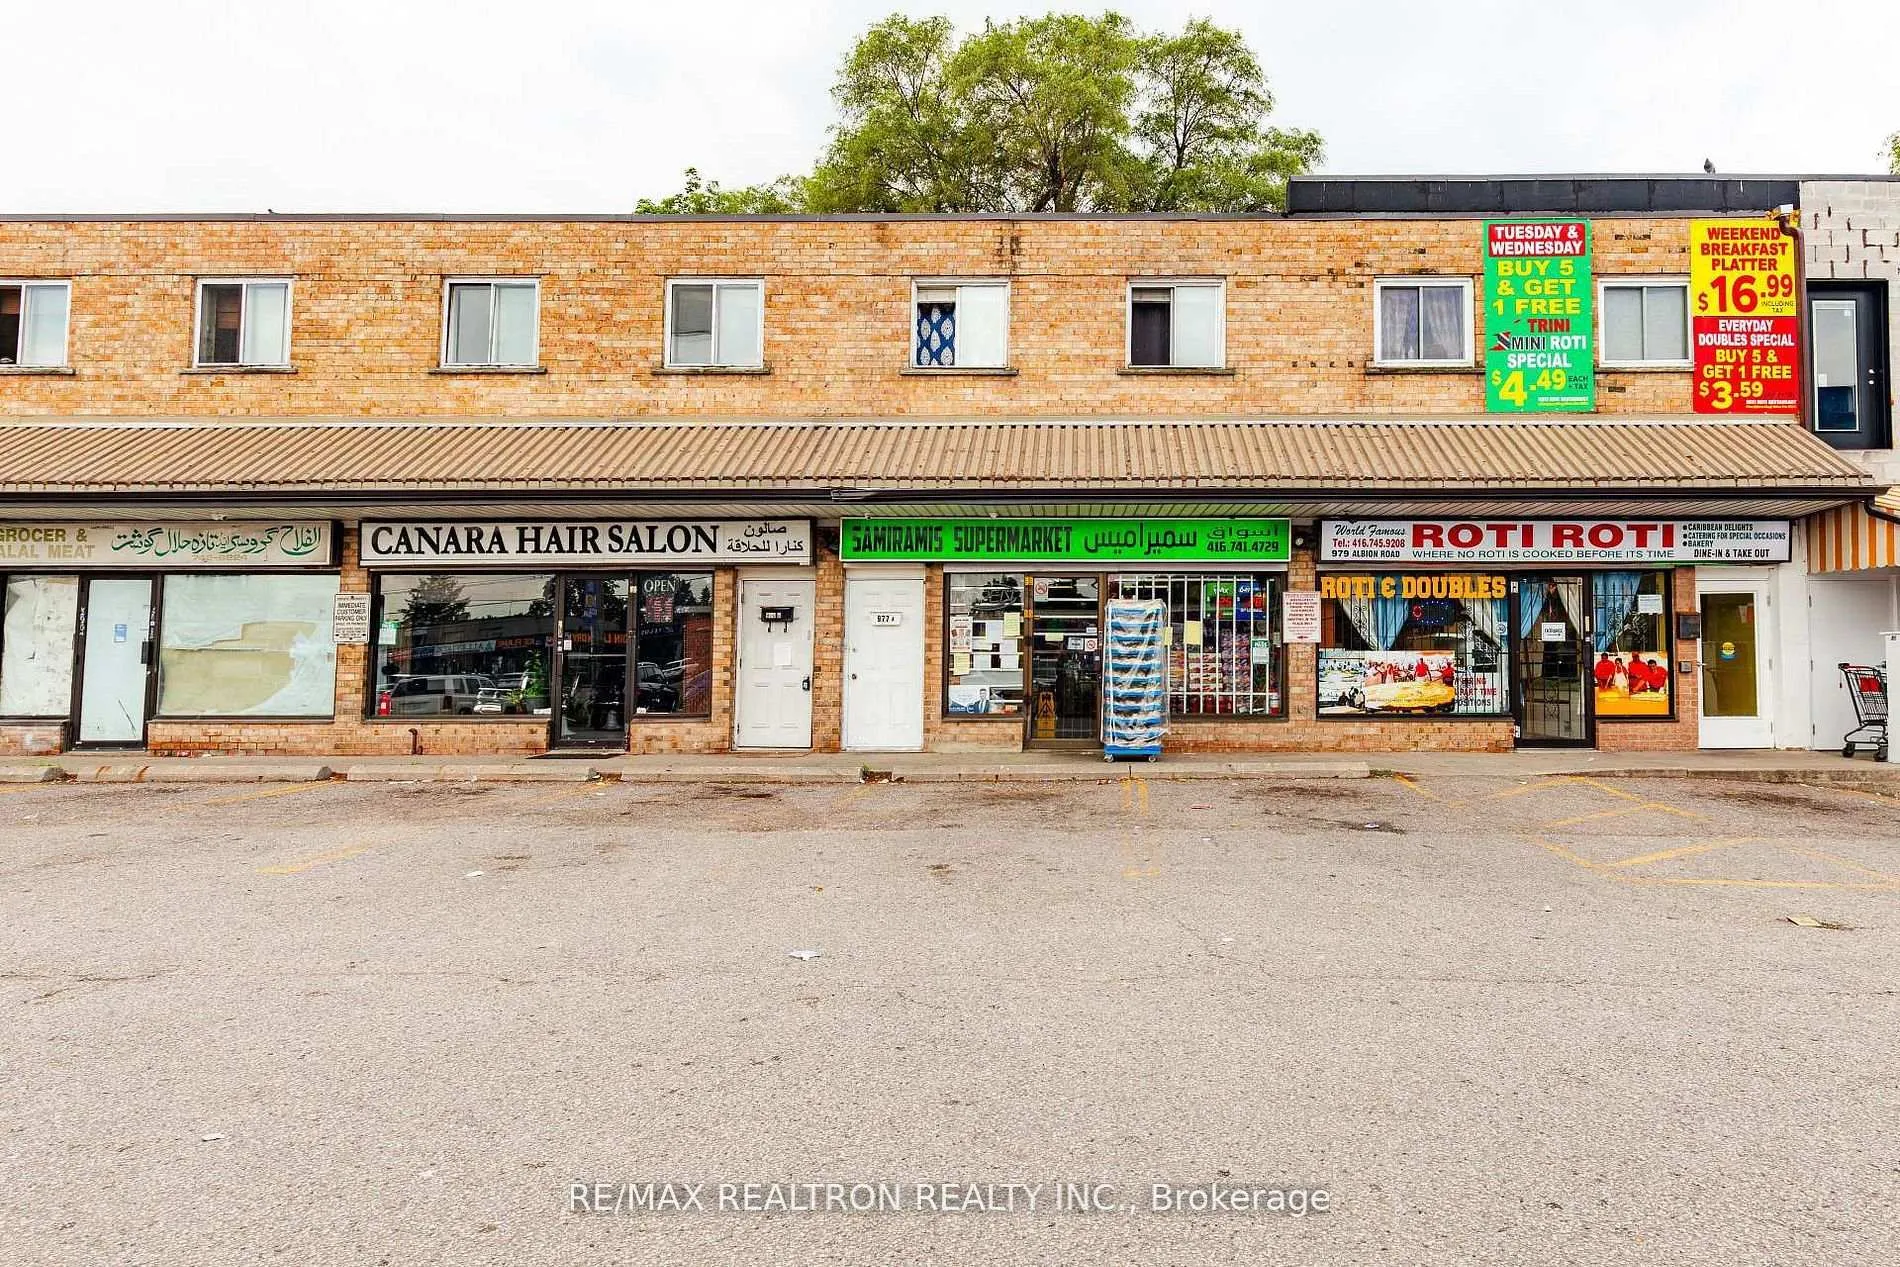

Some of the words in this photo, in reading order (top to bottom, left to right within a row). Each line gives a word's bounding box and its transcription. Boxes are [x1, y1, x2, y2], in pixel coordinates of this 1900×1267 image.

[1495, 225, 1563, 239] TUESDAY
[1567, 225, 1579, 239] &
[1707, 227, 1781, 241] WEEKEND
[1491, 240, 1583, 255] WEDNESDAY
[1700, 243, 1788, 256] BREAKFAST
[1497, 260, 1551, 276] BUY
[1560, 259, 1574, 276] 5
[1711, 258, 1778, 271] PLATTER
[1497, 279, 1515, 296] &
[1524, 279, 1576, 296] GET
[1698, 274, 1793, 313] $16.99
[1493, 299, 1504, 316] 1
[1515, 298, 1580, 315] FREE
[1528, 318, 1570, 333] TRINI
[1718, 319, 1774, 332] EVERYDAY
[1511, 336, 1546, 350] MINI
[1550, 335, 1587, 350] ROTI
[1698, 333, 1748, 346] DOUBLES
[1750, 333, 1795, 346] SPECIAL
[1507, 352, 1572, 368] SPECIAL
[1715, 349, 1748, 363] BUY
[1752, 349, 1761, 363] 5
[1766, 349, 1778, 363] &
[1703, 364, 1734, 379] GET
[1738, 364, 1746, 379] 1
[1752, 364, 1792, 379] FREE
[1491, 369, 1567, 407] $4.49
[1699, 381, 1763, 409] $3.59
[76, 528, 87, 542] &
[743, 522, 787, 537] صالون
[1334, 524, 1366, 537] World
[1368, 524, 1406, 537] Famous
[1411, 523, 1534, 549] ROTI
[1551, 523, 1674, 548] ROTI
[1687, 532, 1715, 540] CATERING
[1717, 532, 1728, 540] FOR
[1729, 532, 1752, 540] SPECIAL
[1753, 532, 1786, 540] OCCASIONS
[280, 525, 321, 556] الفلاح
[371, 526, 509, 555] CANARA
[515, 526, 602, 555] HAIR
[608, 524, 720, 554] SALON
[726, 538, 771, 552] للحلاقة
[852, 526, 943, 552] SAMIRAMIS
[953, 526, 1072, 552] SUPERMARKET
[1083, 522, 1198, 556] سميراميس
[1332, 539, 1350, 548] Tel.:
[1352, 538, 1406, 549] 416.745.9208
[48, 545, 95, 559] MEAT
[1206, 541, 1279, 553] 416.741.4729
[1331, 550, 1349, 558] 979
[1351, 550, 1379, 558] ALBION
[1380, 550, 1400, 558] ROAD
[1412, 550, 1453, 558] WHERE
[1457, 550, 1474, 558] NO
[1478, 550, 1505, 558] ROTI
[1508, 550, 1518, 558] IS
[1522, 550, 1573, 558] COOKED
[1576, 550, 1622, 558] BEFORE
[1625, 550, 1643, 558] ITS
[1646, 550, 1674, 558] TIME
[1693, 549, 1724, 558] DINE-IN
[1725, 549, 1731, 558] &
[1732, 549, 1752, 558] TAKE
[1754, 549, 1770, 558] OUT
[644, 579, 676, 592] OPEN
[1320, 576, 1376, 599] ROTI
[1402, 576, 1506, 599] DOUBLES
